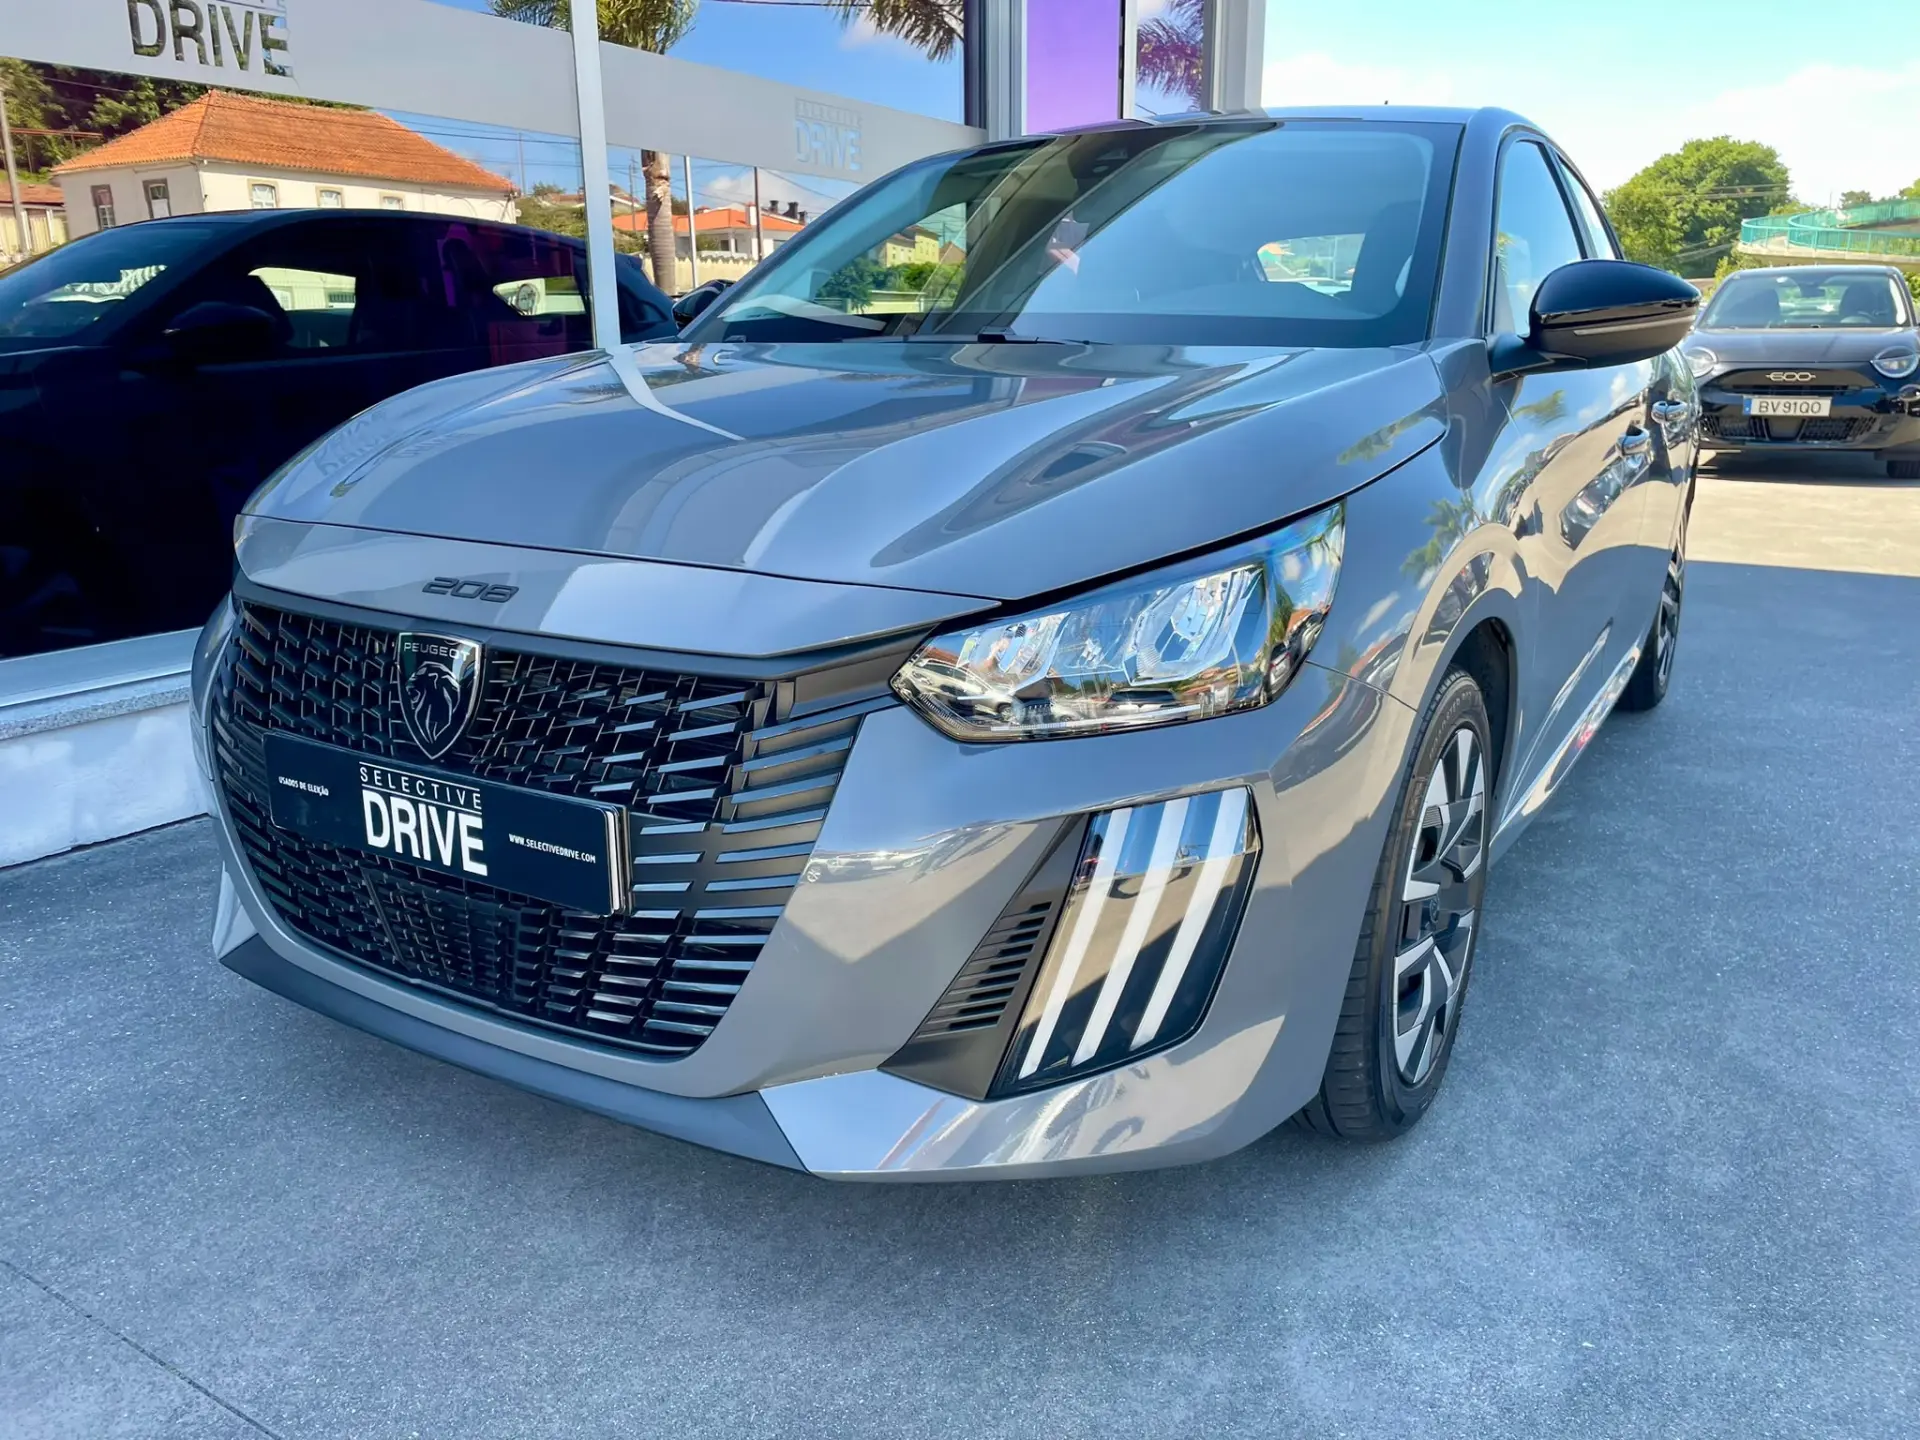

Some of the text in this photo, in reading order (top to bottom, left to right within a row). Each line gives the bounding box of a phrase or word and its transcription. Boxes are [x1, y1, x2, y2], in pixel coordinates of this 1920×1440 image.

[127, 0, 293, 77] DRIVE
[795, 120, 863, 172] DRIVE
[422, 577, 520, 604] 208
[403, 642, 471, 662] PEUGEOT
[299, 781, 307, 791] DE
[360, 766, 483, 810] SELECTIVE
[362, 789, 488, 877] DRIVE
[508, 833, 597, 864] WWW.SELECTIVEDRIVE.COM
